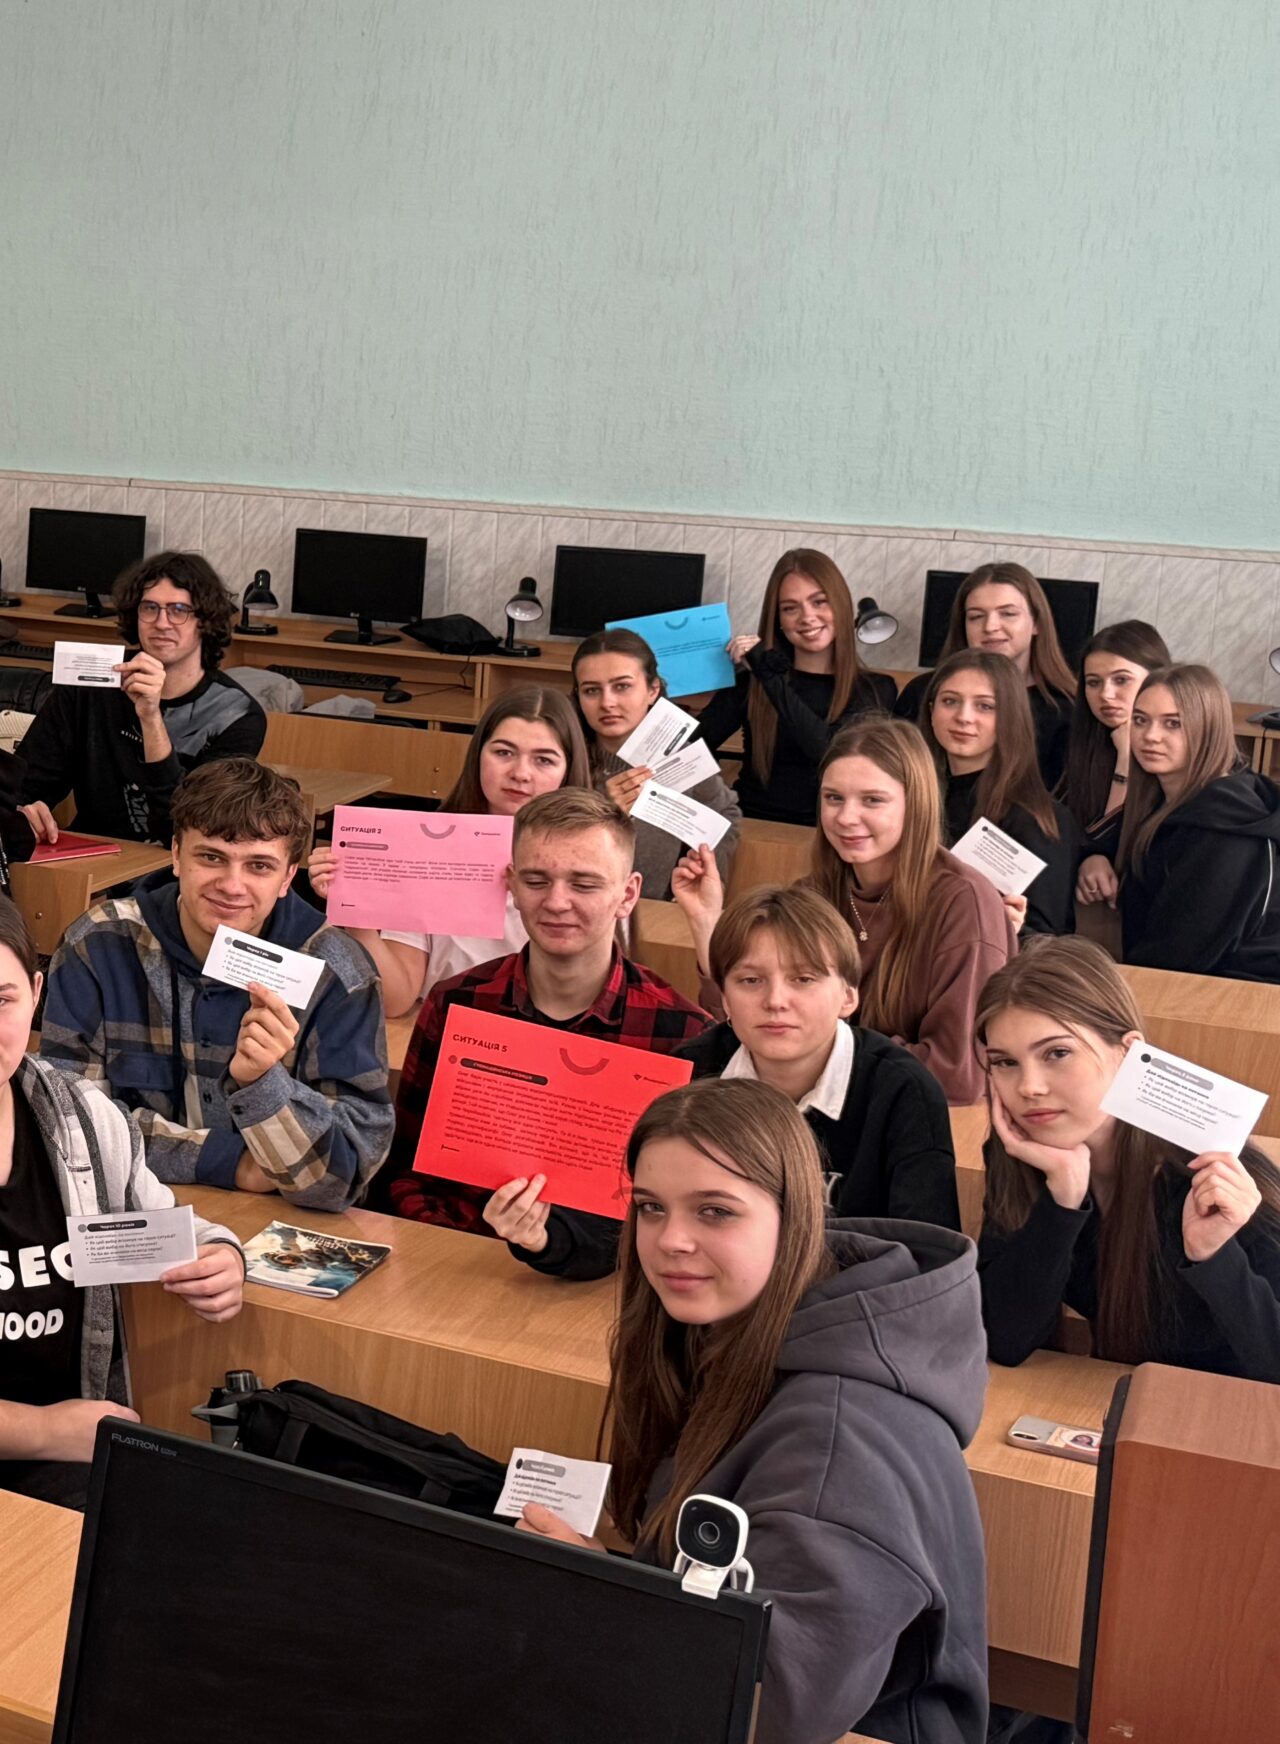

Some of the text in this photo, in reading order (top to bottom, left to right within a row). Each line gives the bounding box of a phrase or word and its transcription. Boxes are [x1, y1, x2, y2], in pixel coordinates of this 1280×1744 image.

[340, 826, 376, 834] СИТУАЦІЯ
[452, 1033, 508, 1053] СИТУАЦІЯ 5
[111, 1432, 159, 1452] FLATRON
